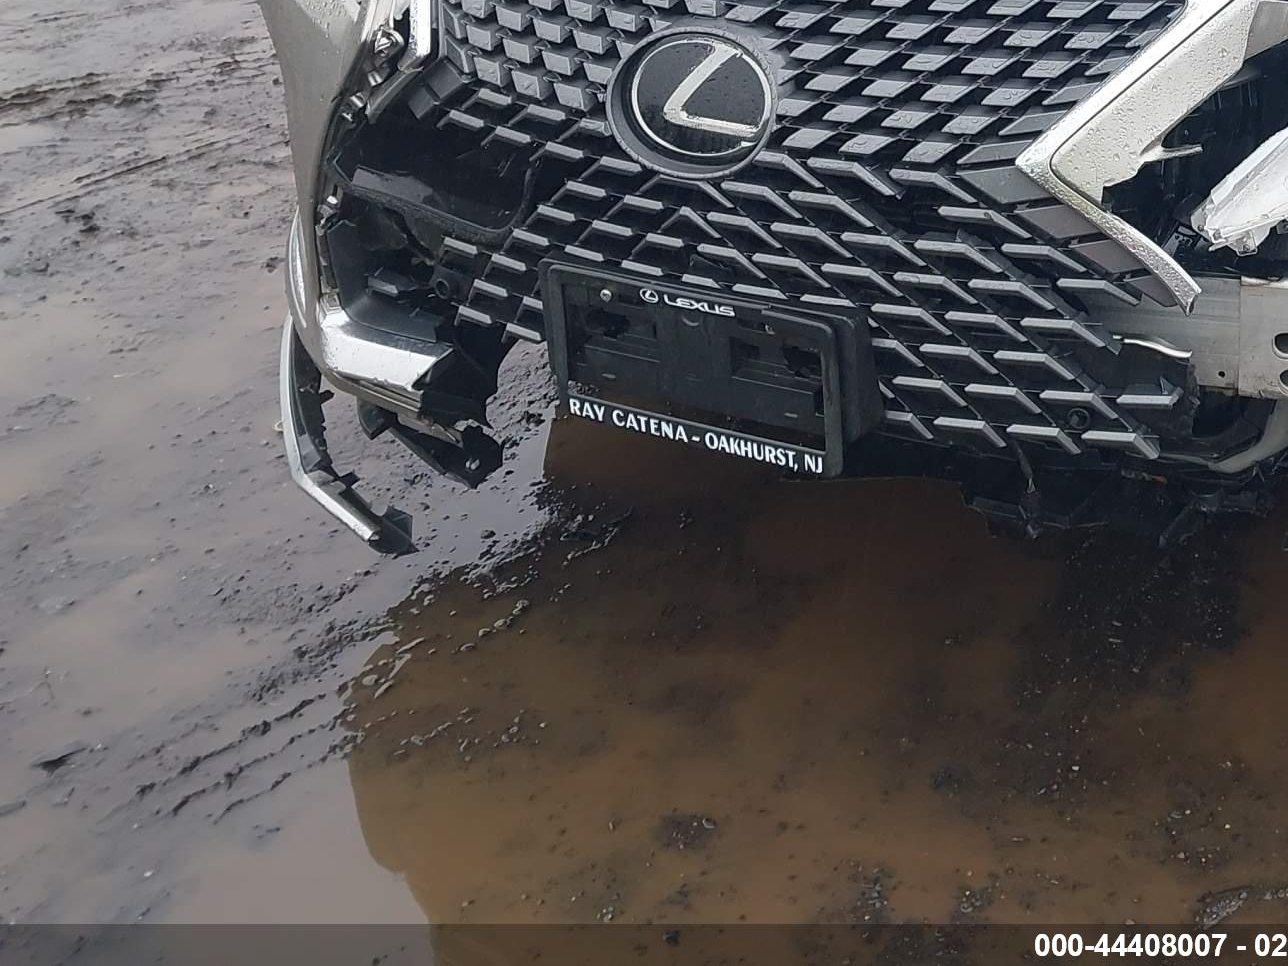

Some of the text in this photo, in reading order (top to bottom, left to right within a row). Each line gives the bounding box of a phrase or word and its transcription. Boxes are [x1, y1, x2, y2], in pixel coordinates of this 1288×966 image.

[663, 293, 736, 317] LEXUS
[568, 397, 606, 422] RAY
[612, 408, 689, 443] CATENA
[705, 431, 799, 472] OAKHURST,
[804, 455, 823, 474] NJ
